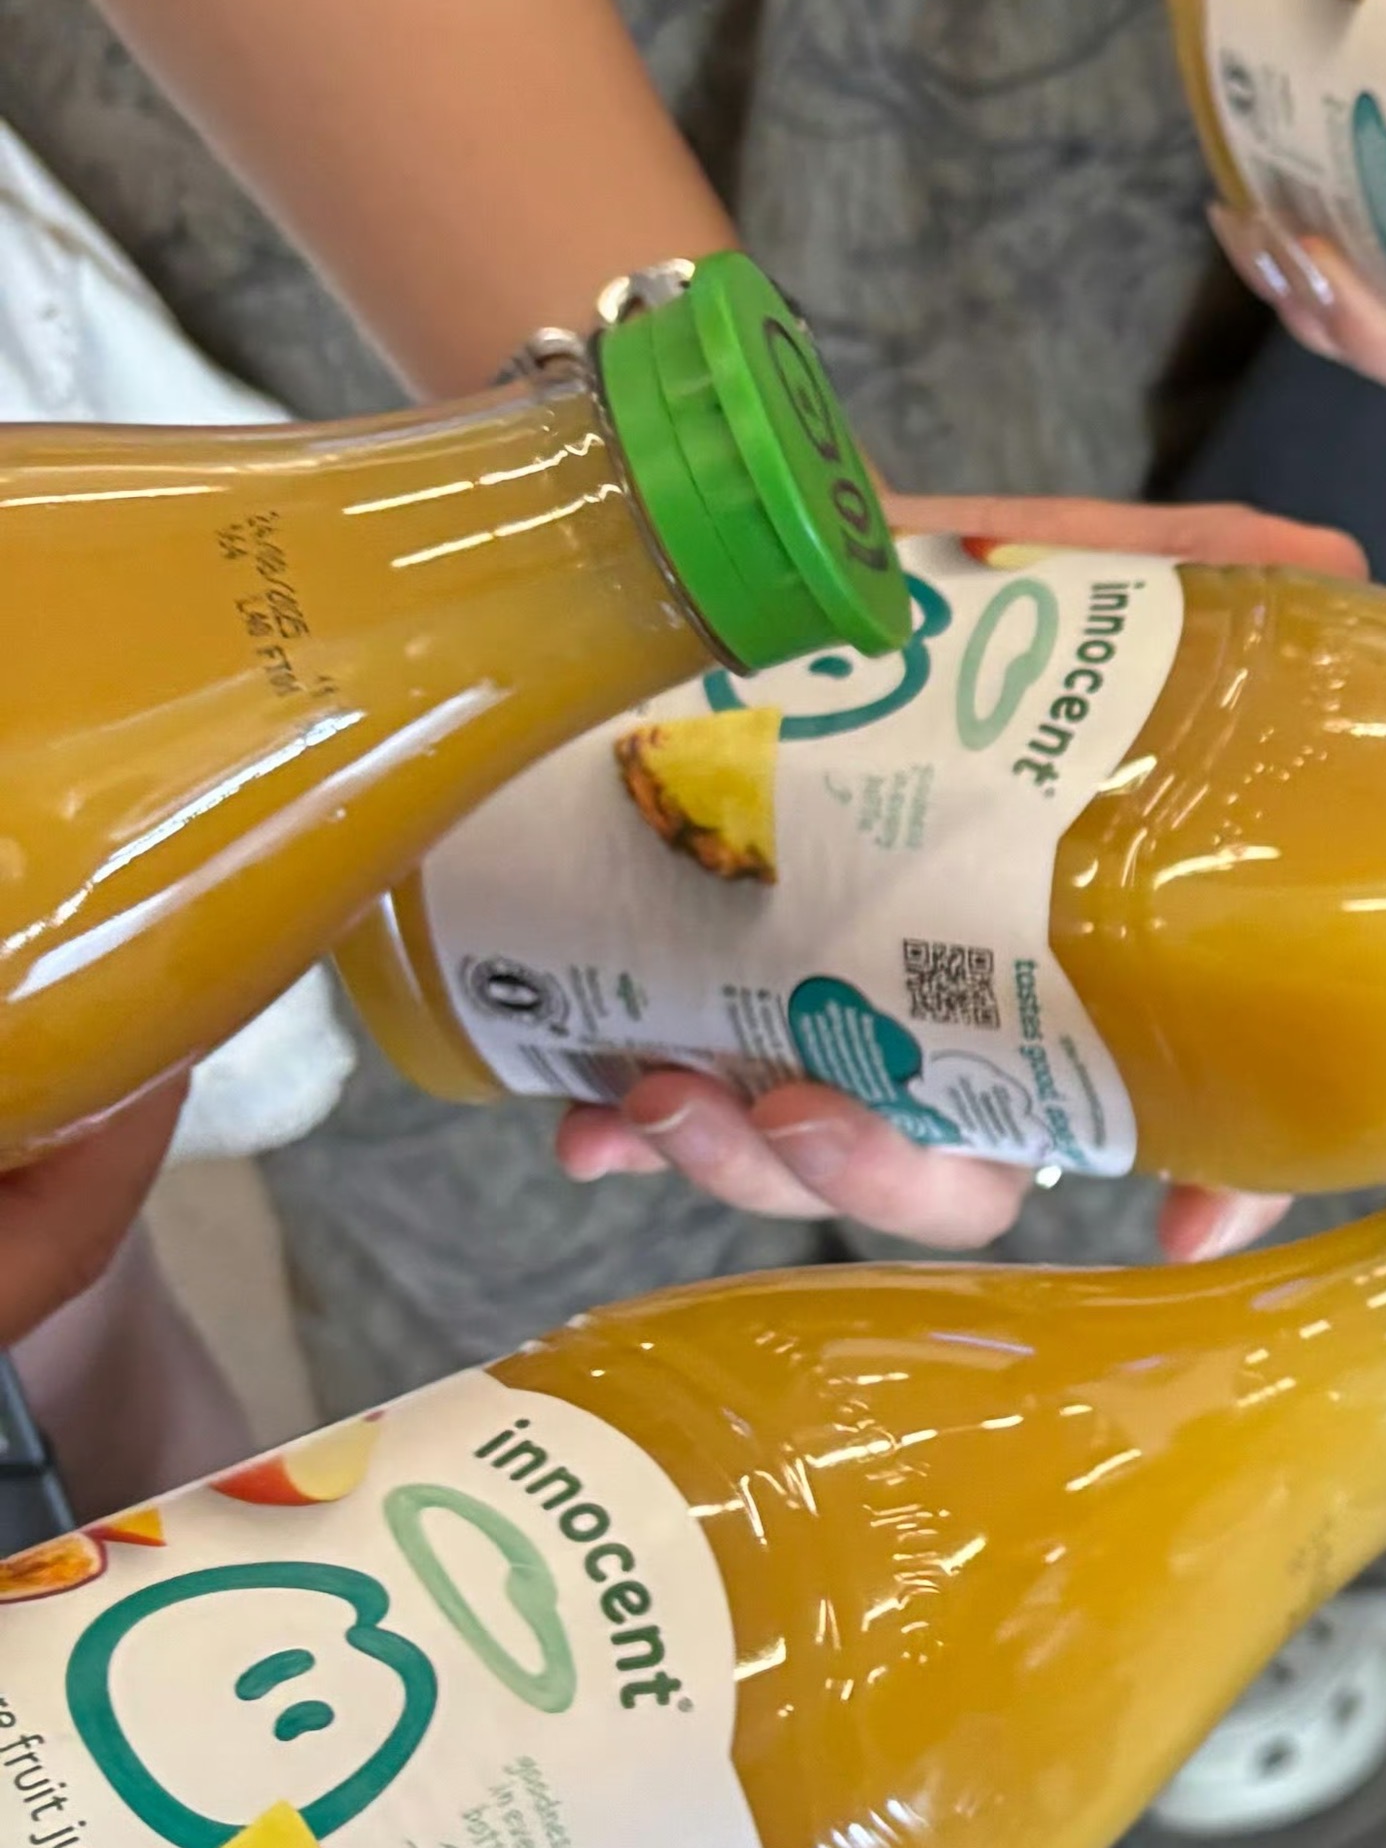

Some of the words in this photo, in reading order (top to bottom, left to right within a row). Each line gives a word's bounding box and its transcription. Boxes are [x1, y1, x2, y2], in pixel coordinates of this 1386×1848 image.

[1012, 580, 1146, 786] innocent
[474, 1418, 682, 1709] innocent
[0, 1733, 69, 1823] fruit
